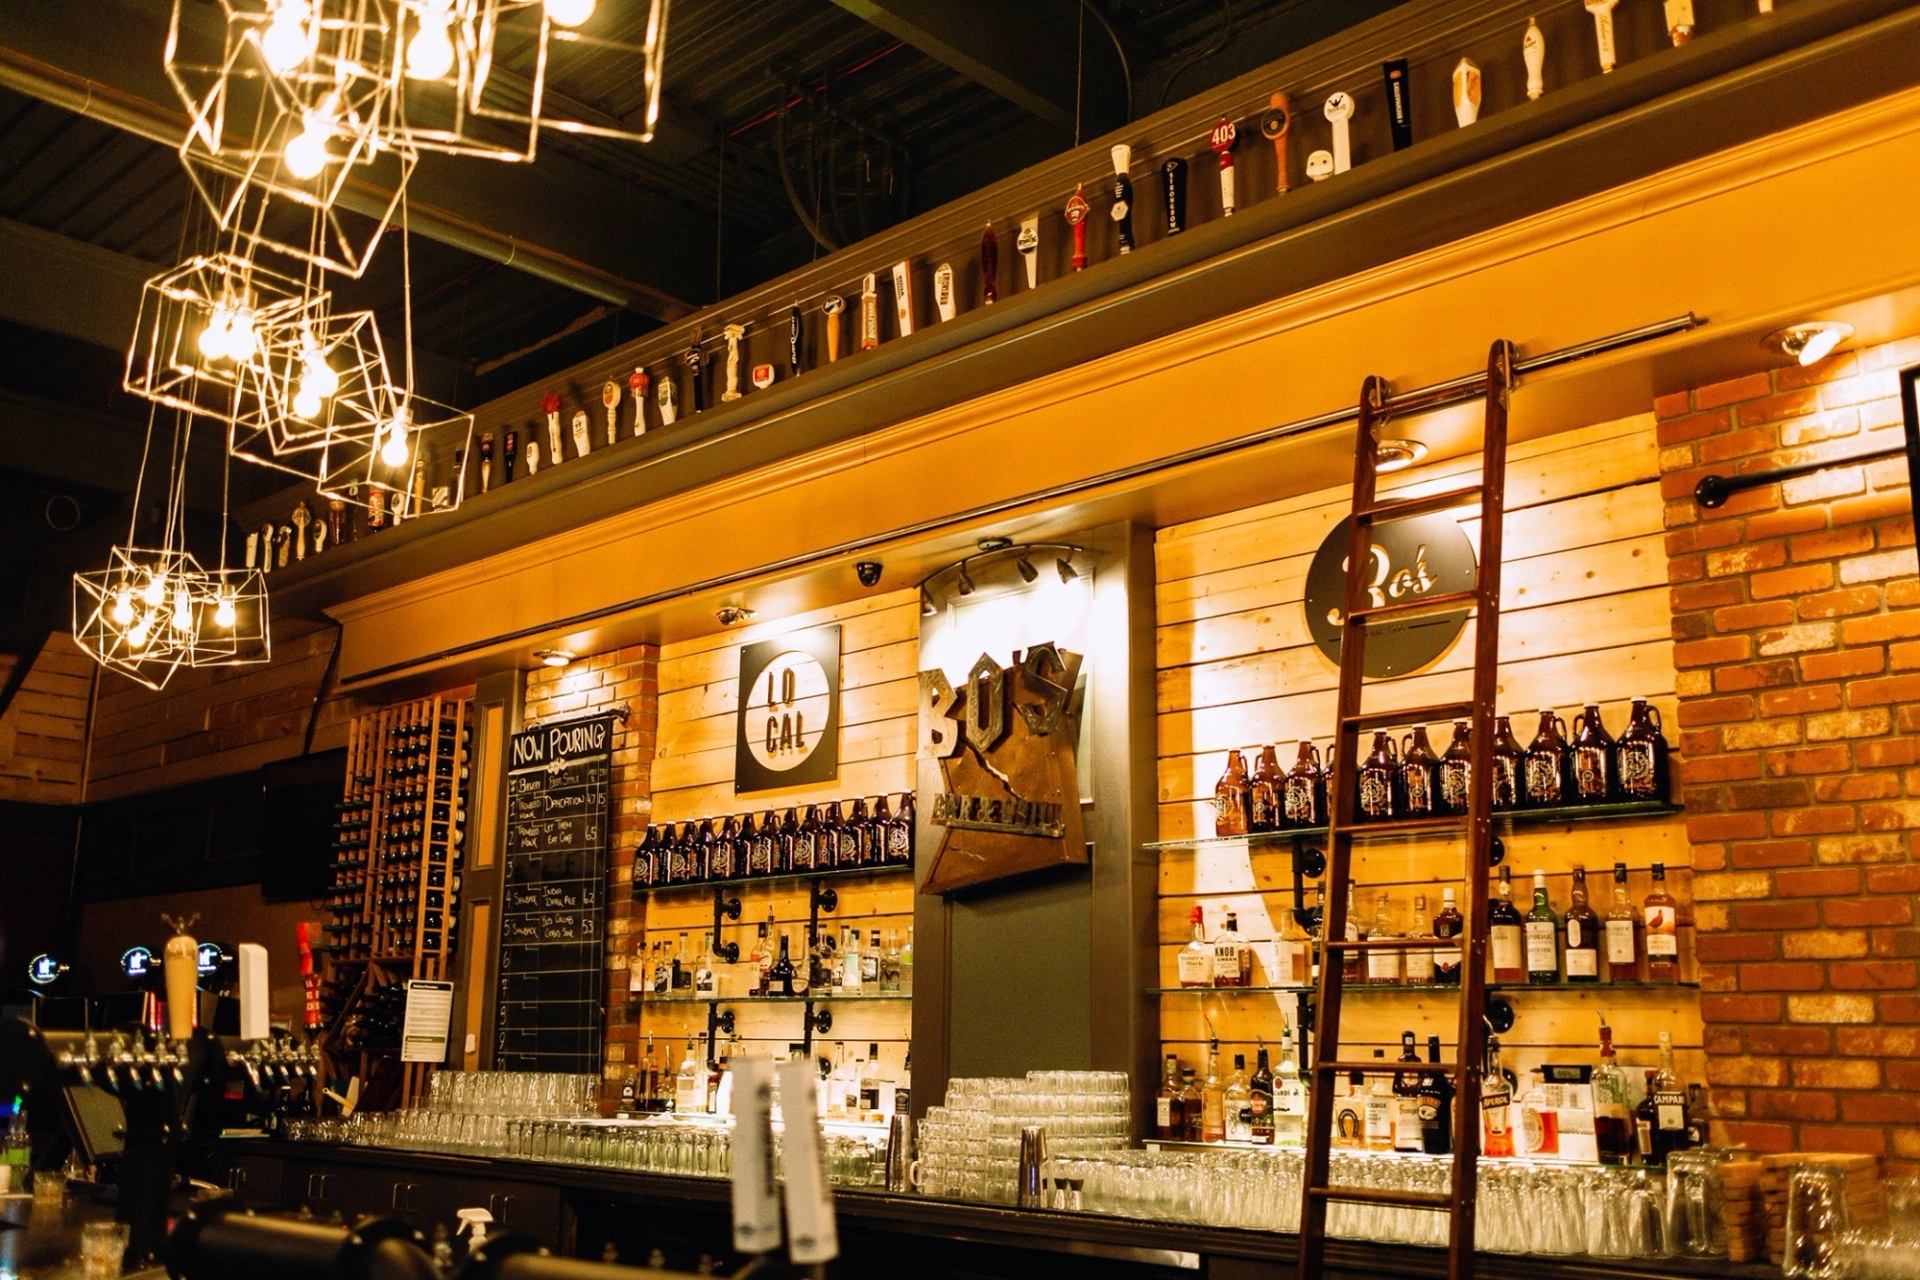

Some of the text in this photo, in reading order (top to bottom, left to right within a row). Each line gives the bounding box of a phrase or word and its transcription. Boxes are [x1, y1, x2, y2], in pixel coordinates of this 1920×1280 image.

[1211, 123, 1236, 145] 403
[1168, 171, 1176, 229] STRONGBOW
[767, 667, 795, 707] LO
[766, 711, 805, 753] CAL
[513, 733, 545, 766] NOW
[549, 723, 606, 759] POURING
[508, 831, 514, 846] 2
[502, 950, 510, 969] 6
[1214, 946, 1236, 957] KNOB
[500, 1005, 507, 1025] 8
[498, 1031, 506, 1050] 9
[1653, 1095, 1685, 1105] CAMPARI
